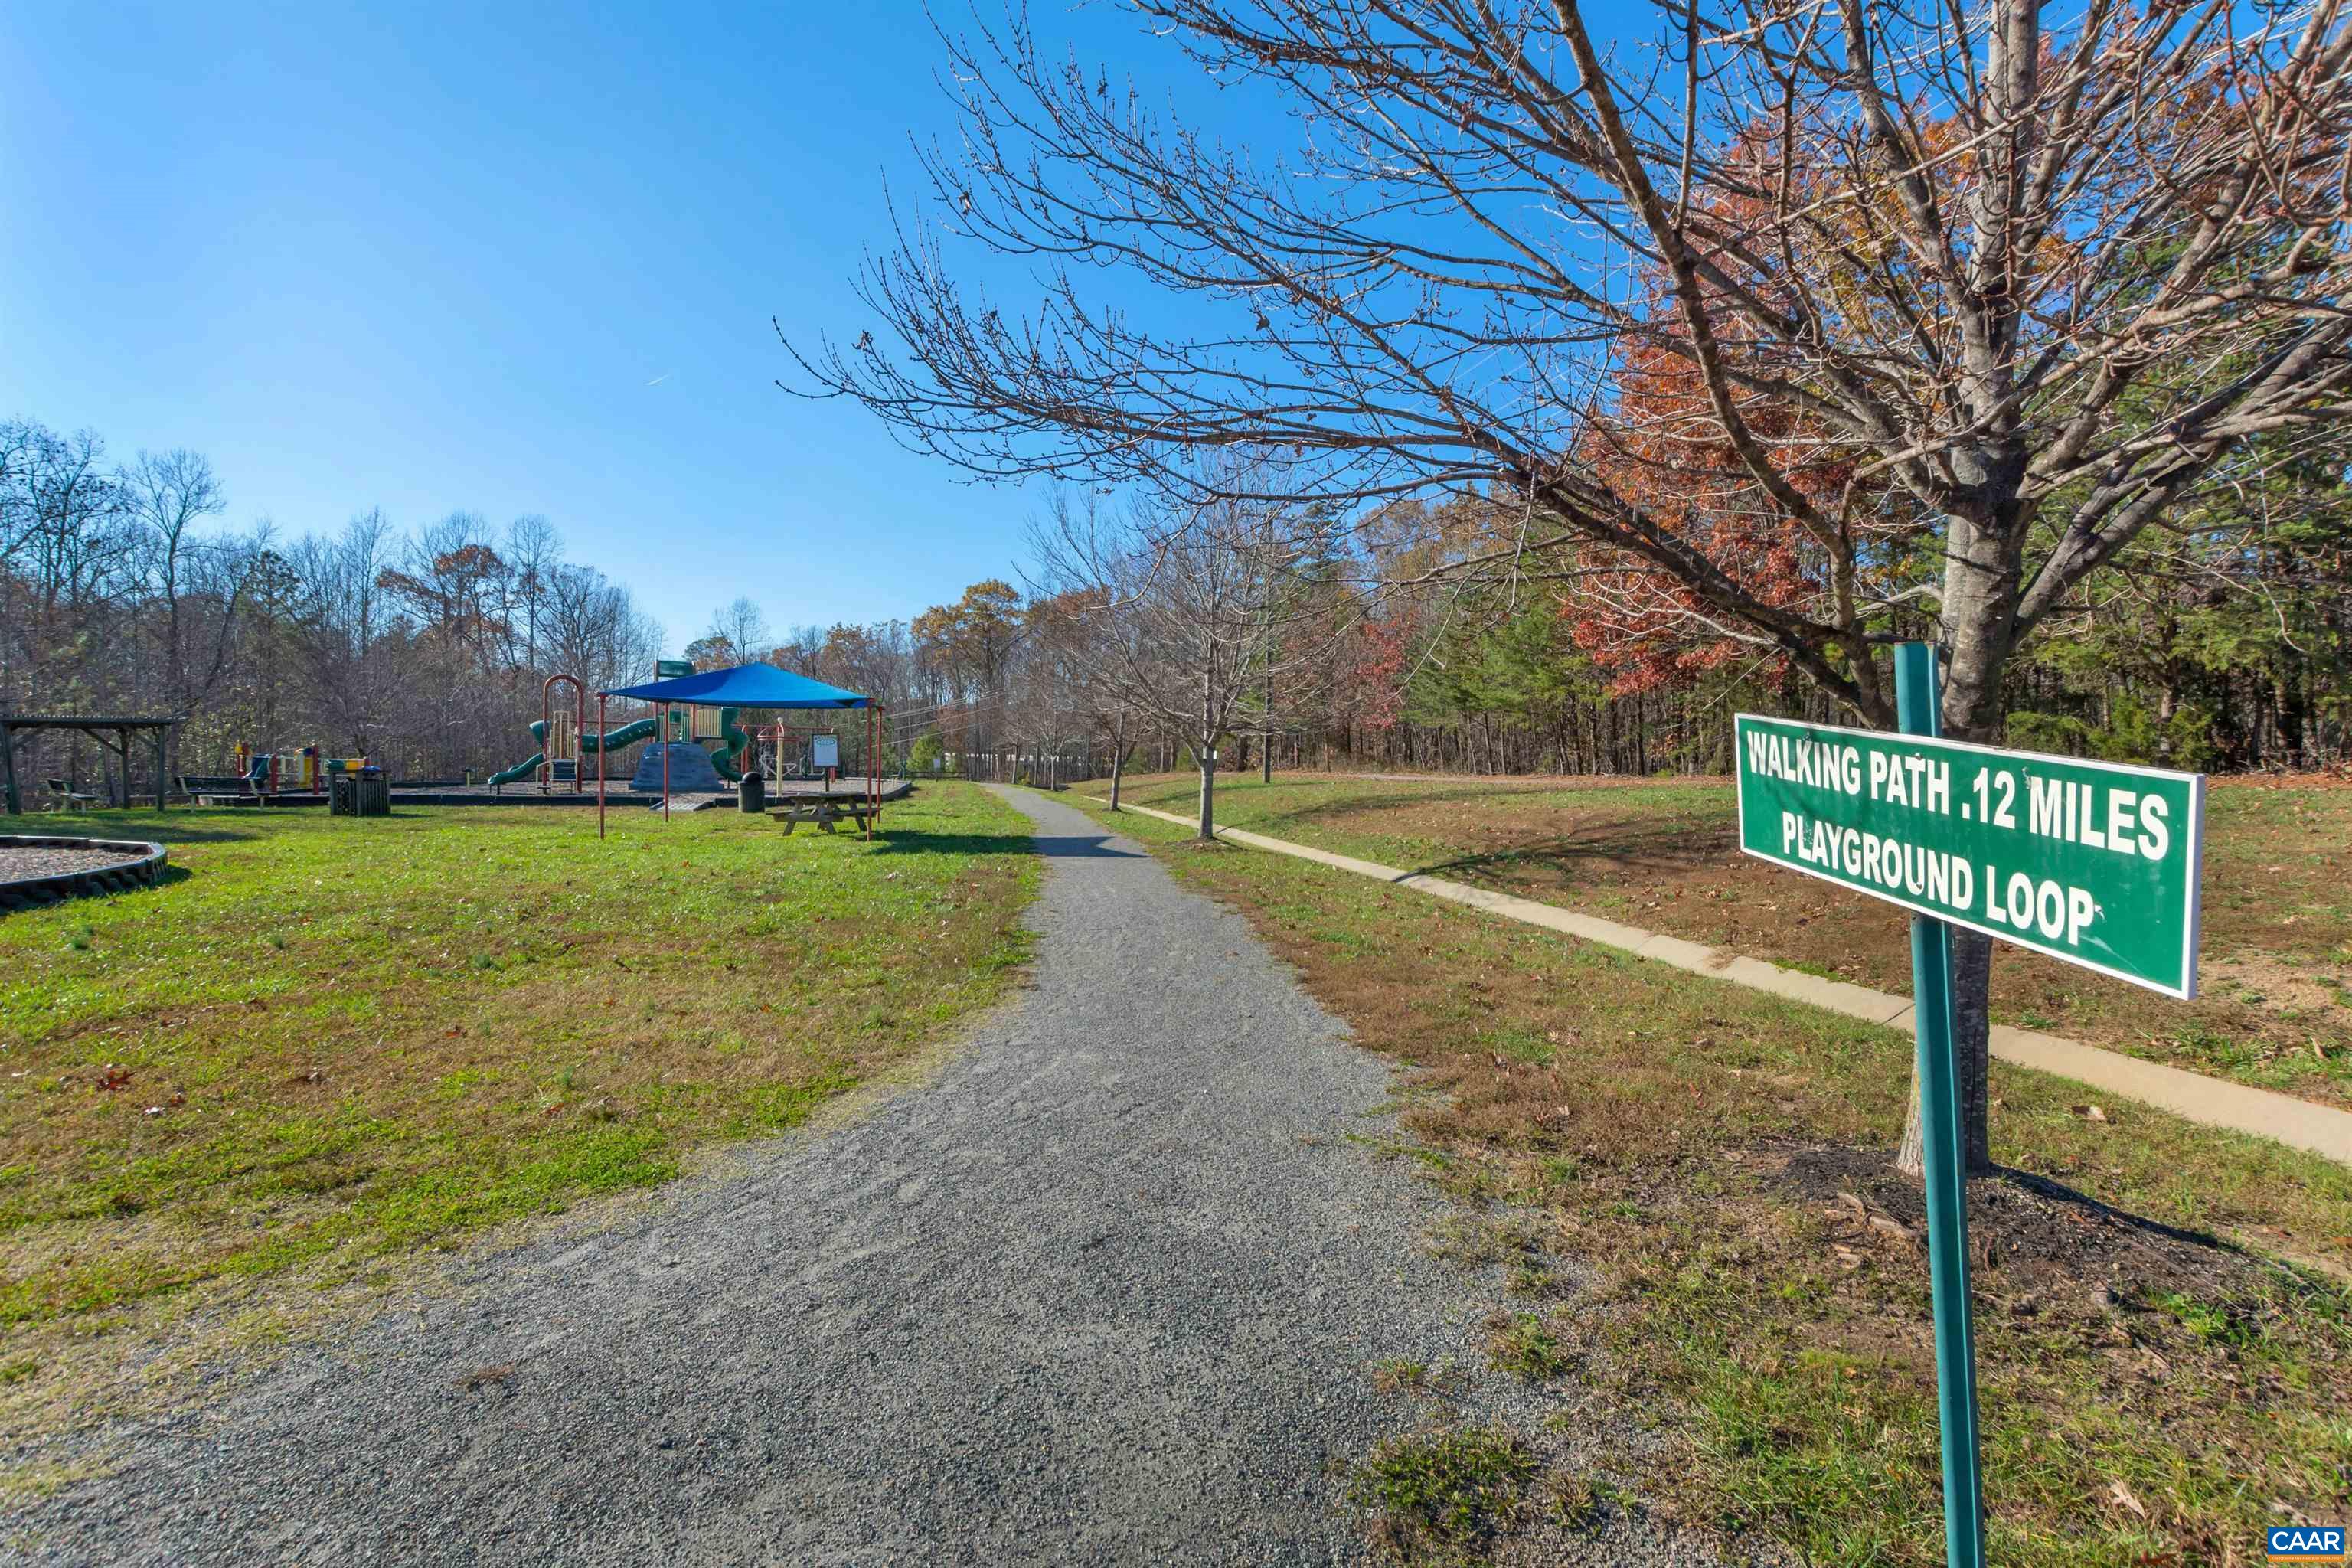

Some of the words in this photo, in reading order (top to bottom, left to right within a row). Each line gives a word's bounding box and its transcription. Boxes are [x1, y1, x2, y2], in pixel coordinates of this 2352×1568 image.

[1746, 730, 1861, 795] WALKING
[1870, 750, 1949, 815] PATH
[1962, 767, 2016, 829] .12
[2028, 776, 2169, 861] MILES
[1782, 811, 1974, 910] PLAYGROUND
[1986, 865, 2095, 946] LOOP
